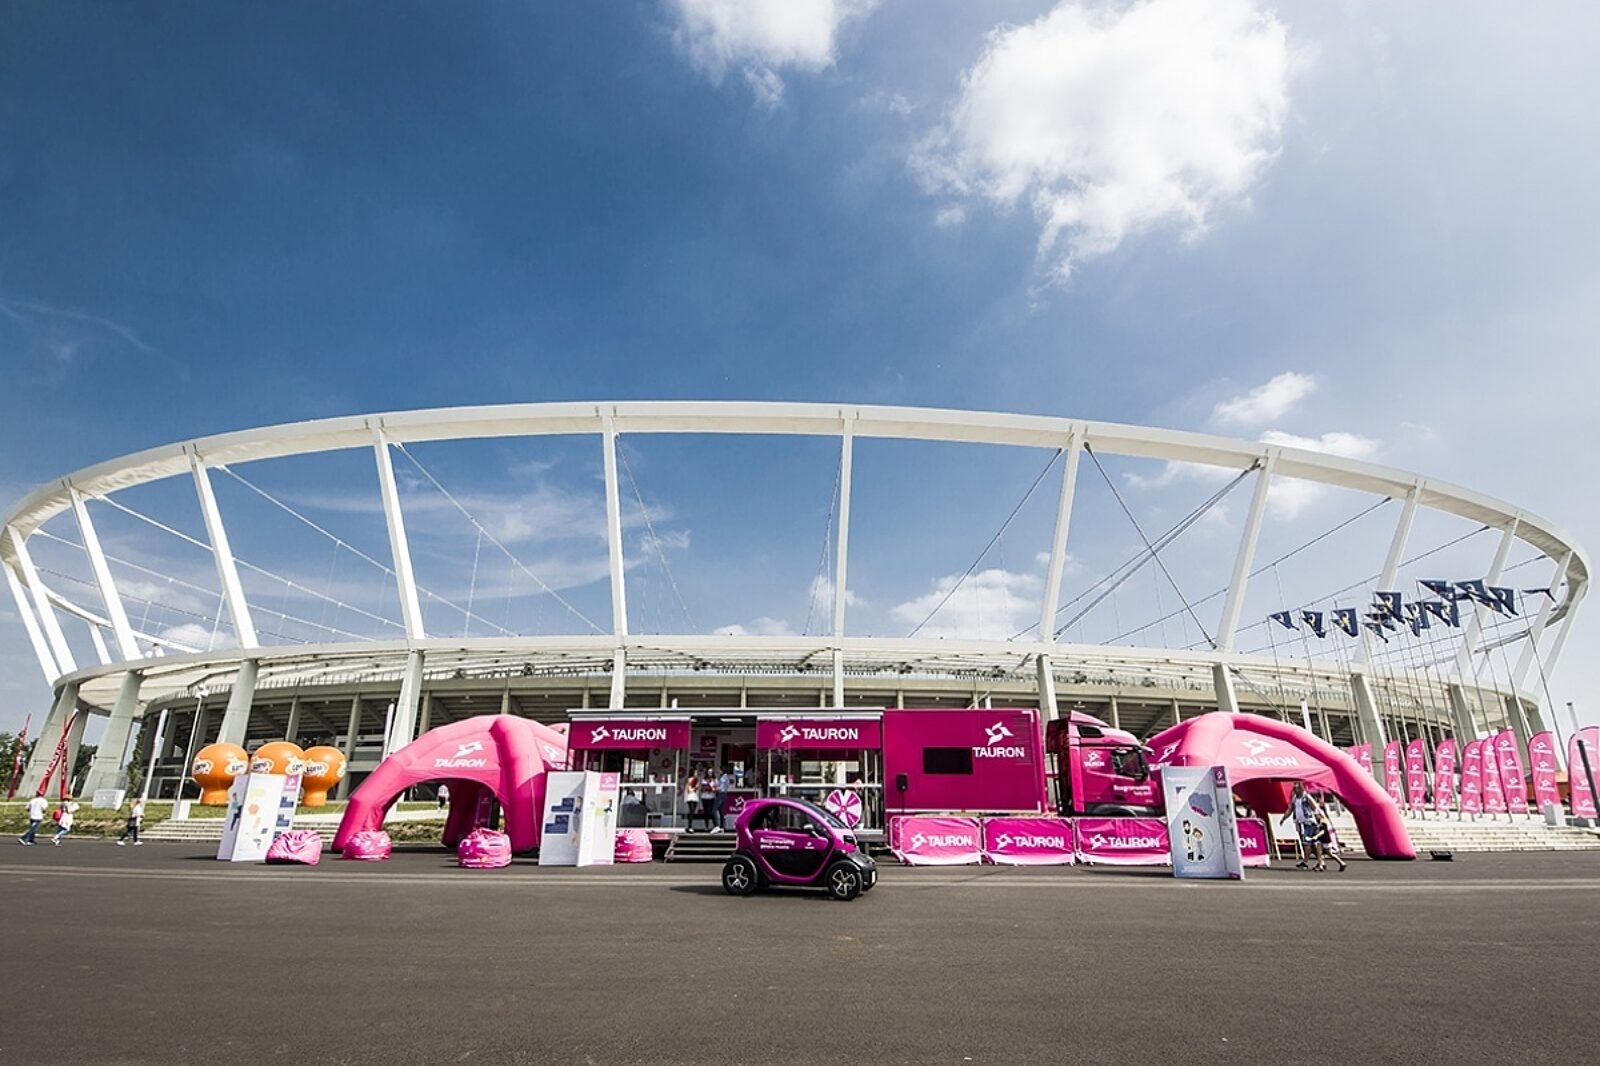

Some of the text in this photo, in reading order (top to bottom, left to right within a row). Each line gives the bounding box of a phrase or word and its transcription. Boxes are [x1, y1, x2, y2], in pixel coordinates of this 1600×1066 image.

[611, 728, 667, 740] TAURON
[801, 728, 859, 740] TAURON
[972, 747, 1025, 758] TAURON
[433, 758, 488, 768] TAURON
[1234, 755, 1300, 767] TAURON
[926, 835, 973, 847] TAURON
[1013, 836, 1065, 848] TAURON
[1107, 837, 1161, 848] TAURON
